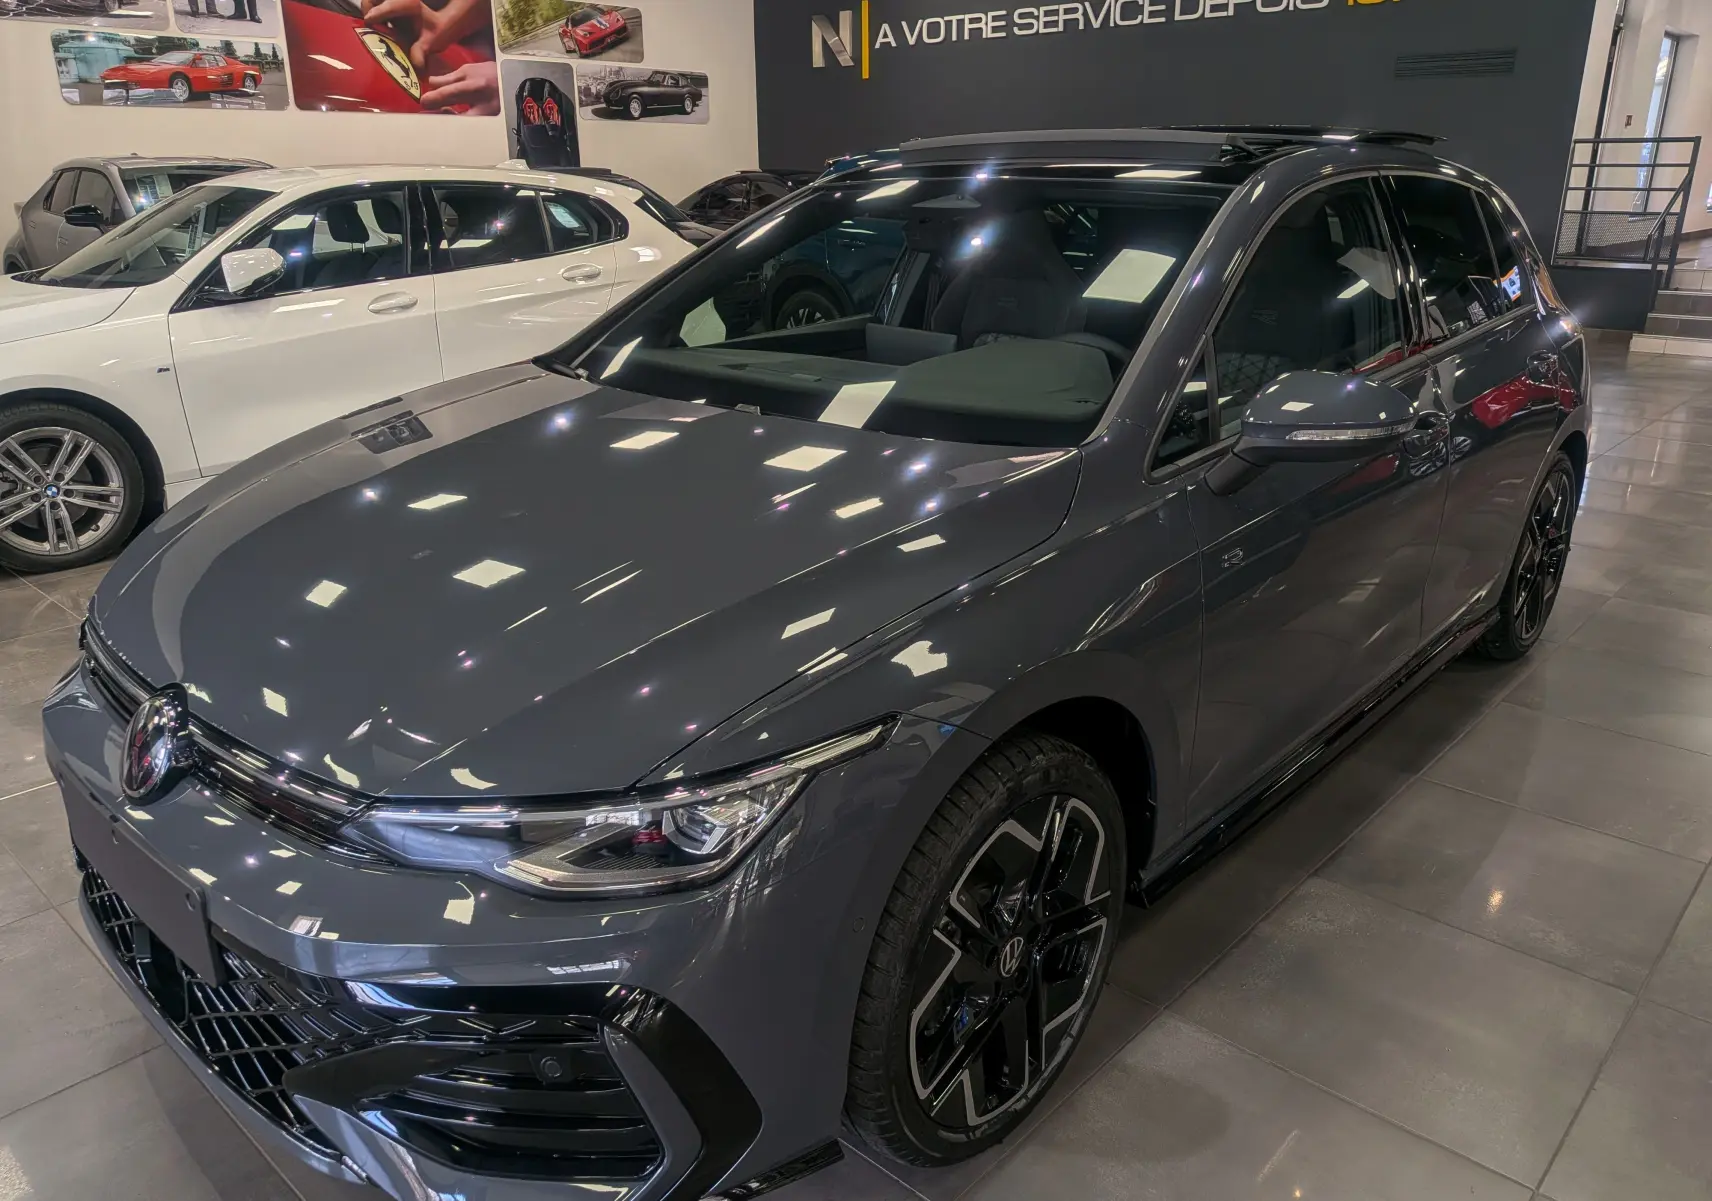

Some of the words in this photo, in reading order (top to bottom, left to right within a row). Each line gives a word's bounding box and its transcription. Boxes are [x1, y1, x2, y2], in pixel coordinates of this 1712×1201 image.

[811, 10, 855, 68] N
[874, 23, 898, 49] A
[901, 10, 1007, 46] VOTRE
[1013, 0, 1167, 35] SERVICE
